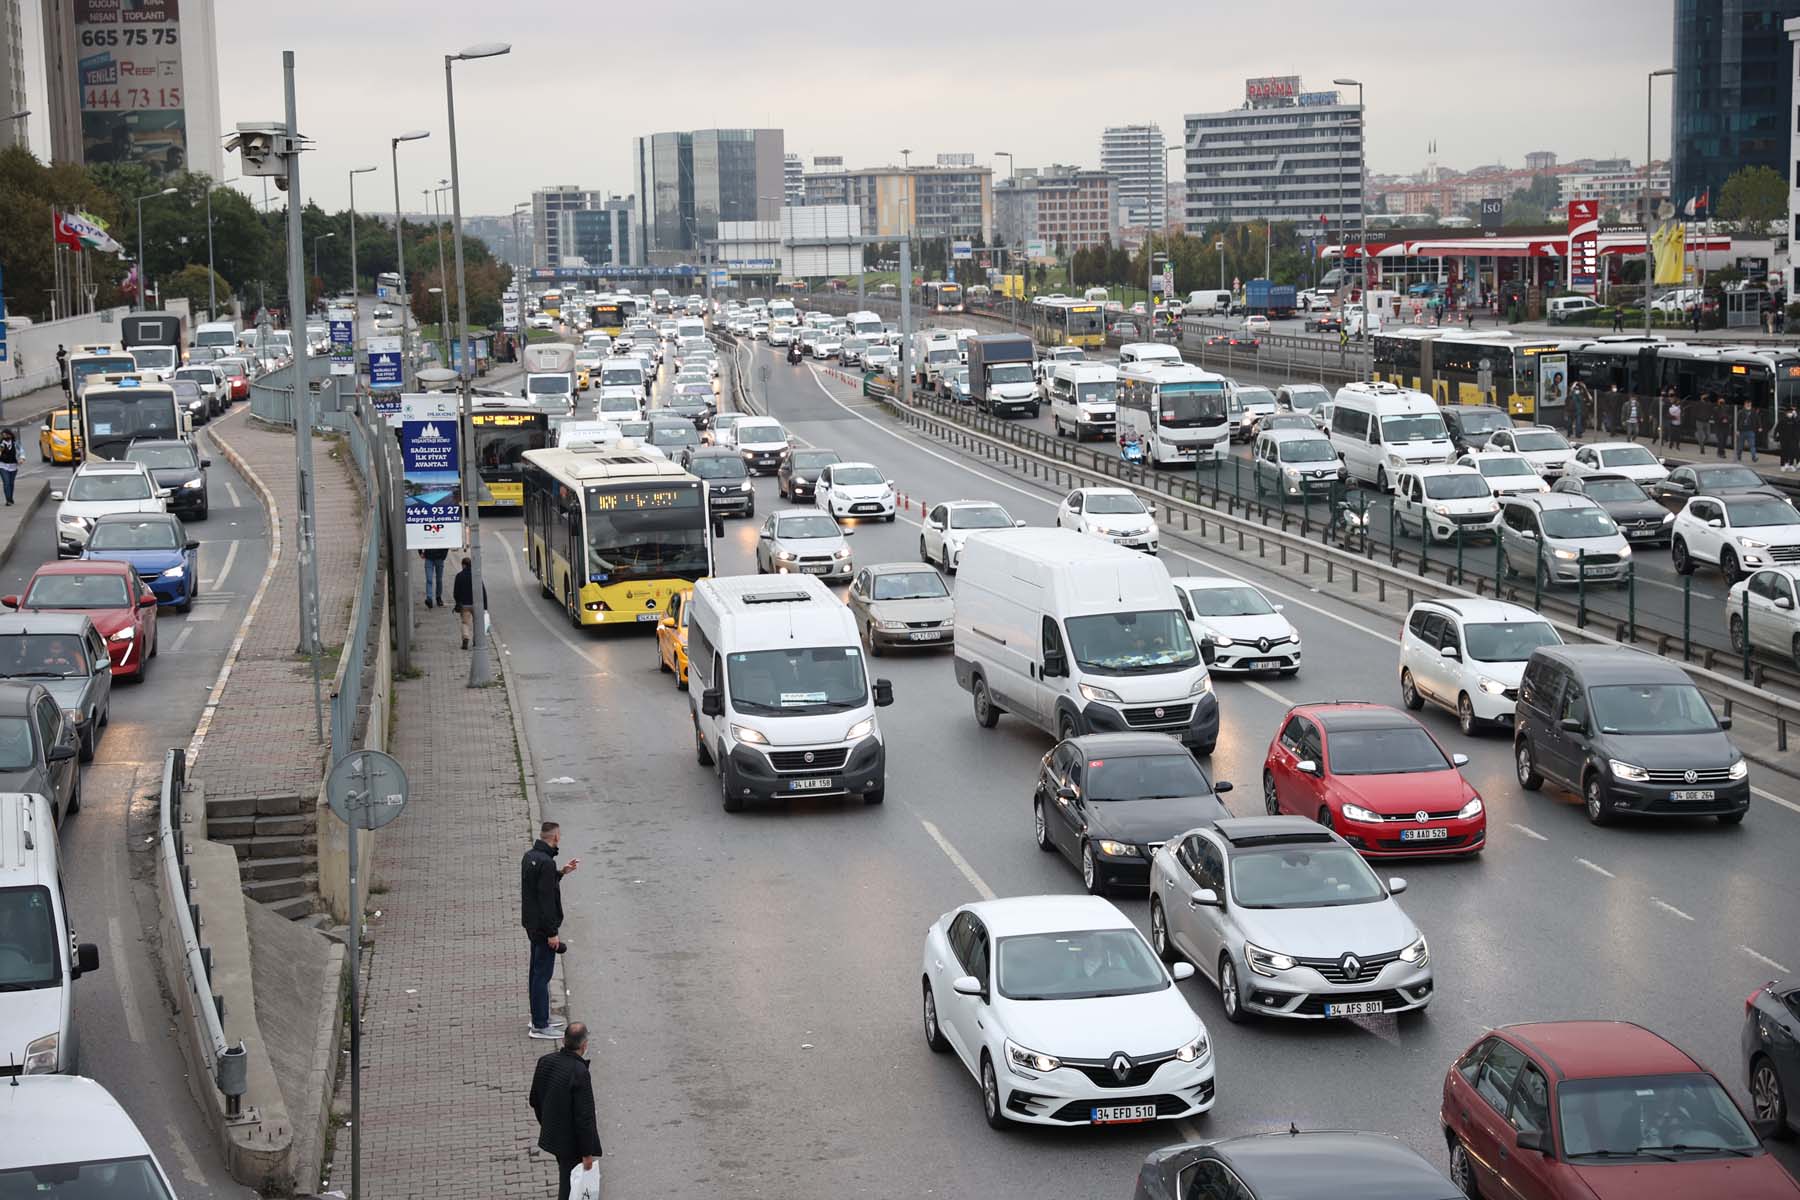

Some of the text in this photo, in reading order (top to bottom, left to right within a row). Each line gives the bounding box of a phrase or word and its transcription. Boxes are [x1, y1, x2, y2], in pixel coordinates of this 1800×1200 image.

[125, 11, 164, 21] TOPLANTI
[82, 28, 177, 46] 665 75 75
[87, 87, 180, 108] 444 73 15
[407, 506, 460, 515] 444 93 27
[424, 524, 445, 533] DAP
[1405, 830, 1414, 839] 69
[1432, 829, 1446, 838] 526
[1331, 1001, 1381, 1015] 34 AFS 801
[1097, 1105, 1153, 1120] 34 EFD 510
